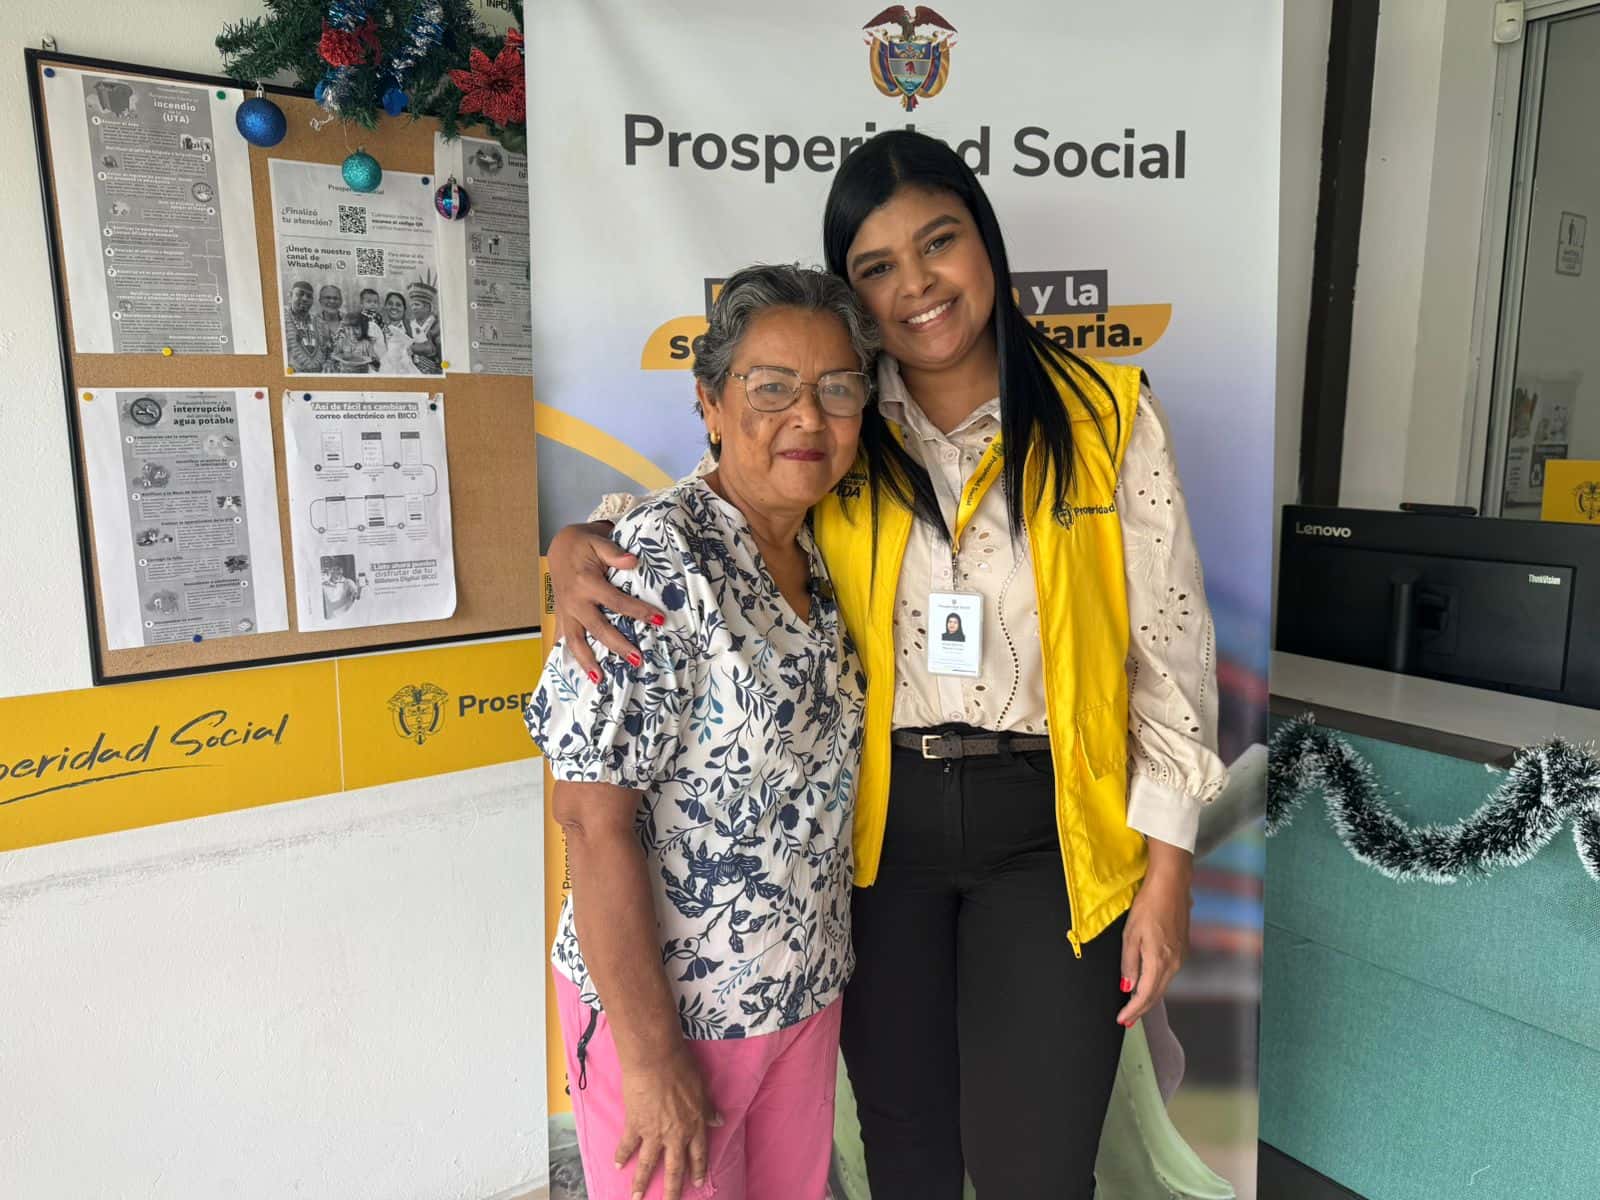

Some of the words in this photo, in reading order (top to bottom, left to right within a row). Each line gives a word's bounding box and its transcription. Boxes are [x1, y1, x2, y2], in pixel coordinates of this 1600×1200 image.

[153, 98, 196, 112] incendio
[163, 111, 190, 124] (UTA)
[624, 112, 989, 184] Prosperd
[1012, 126, 1186, 179] Social
[293, 217, 333, 227] atención?
[287, 260, 332, 270] WhatsApp!
[1031, 286, 1054, 315] y
[1065, 276, 1099, 307] la
[173, 404, 232, 414] interrupción
[342, 411, 386, 420] electrónico
[397, 411, 417, 420] BICO
[173, 418, 195, 426] agua
[199, 416, 234, 427] potable
[1295, 520, 1352, 538] Lenovo
[170, 710, 289, 757] Social
